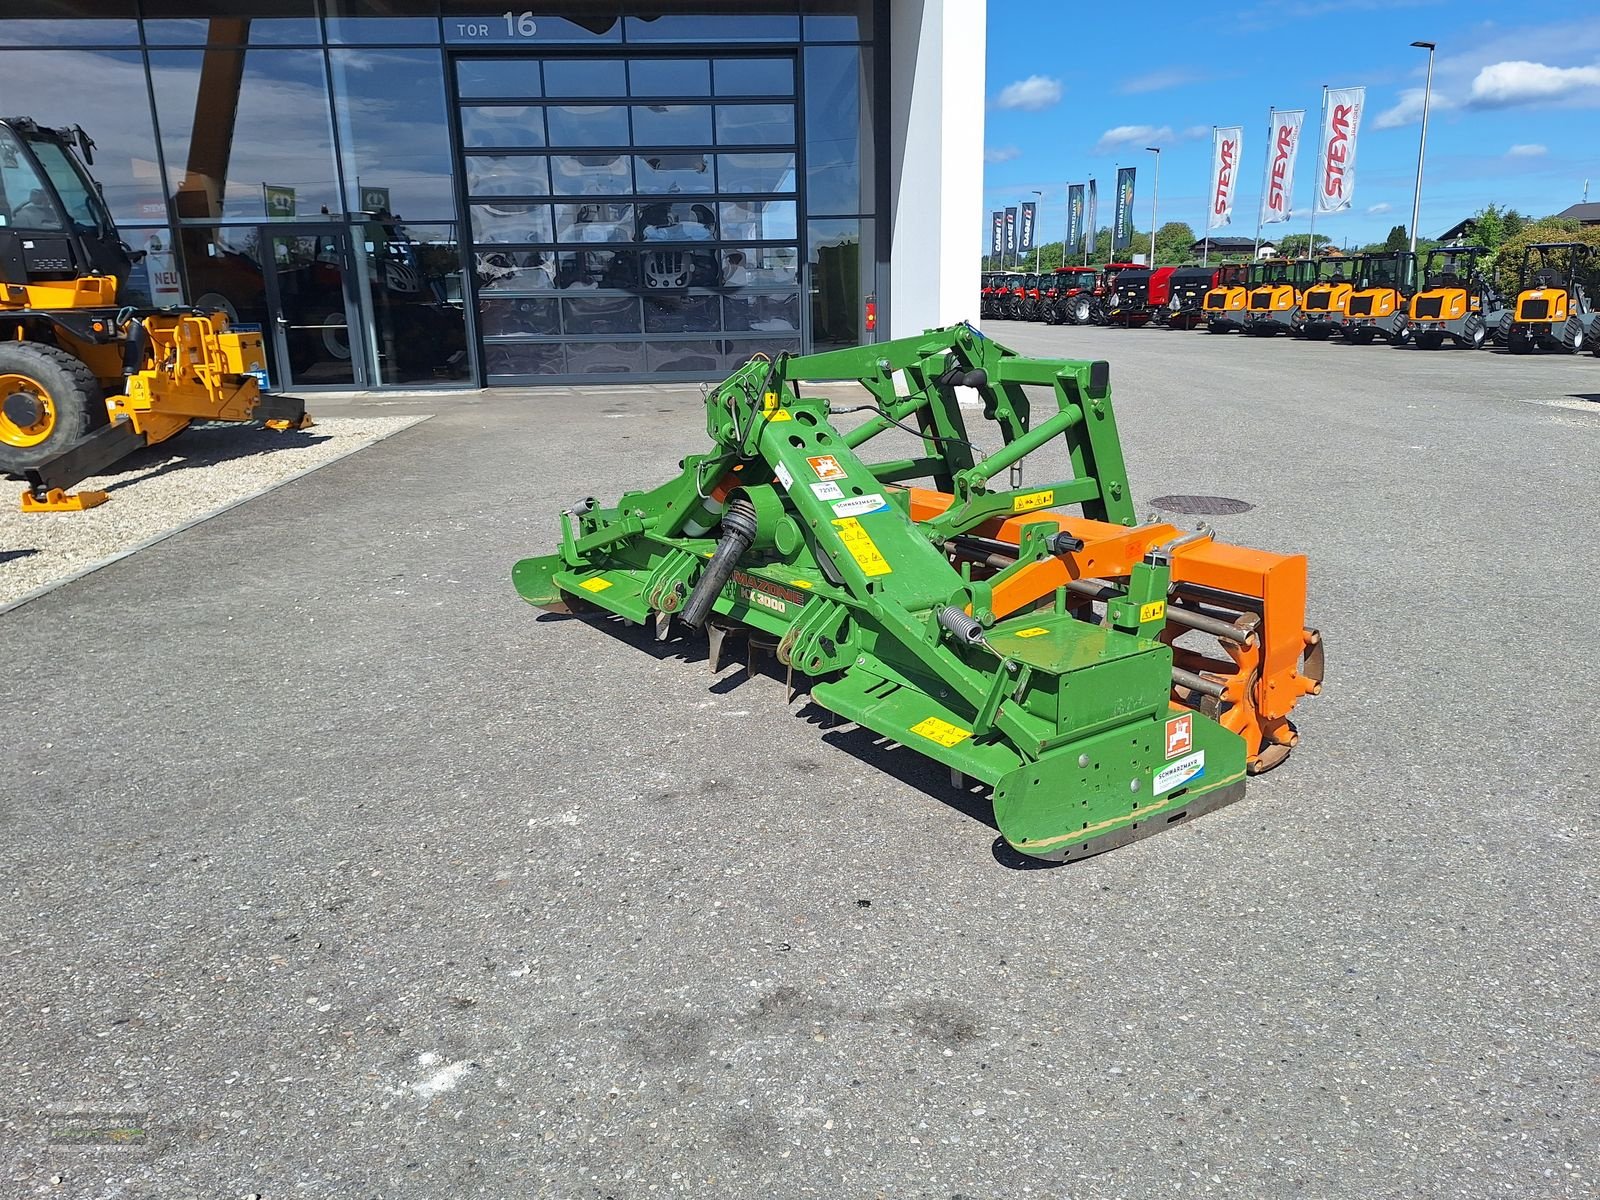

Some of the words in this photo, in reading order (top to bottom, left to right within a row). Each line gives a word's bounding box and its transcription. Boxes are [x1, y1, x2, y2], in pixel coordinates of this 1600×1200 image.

[457, 24, 489, 37] TOR
[503, 11, 537, 37] 16
[1325, 104, 1353, 199] STEYR
[1215, 140, 1235, 215] STEYR
[1269, 125, 1294, 212] STEYR
[1118, 184, 1126, 239] SCHWARZMAYR
[1023, 219, 1031, 247] CASE
[154, 271, 178, 285] NEU
[730, 569, 805, 607] MAZONE
[757, 593, 786, 613] 3000
[1158, 759, 1198, 780] SCHWARZMAYR
